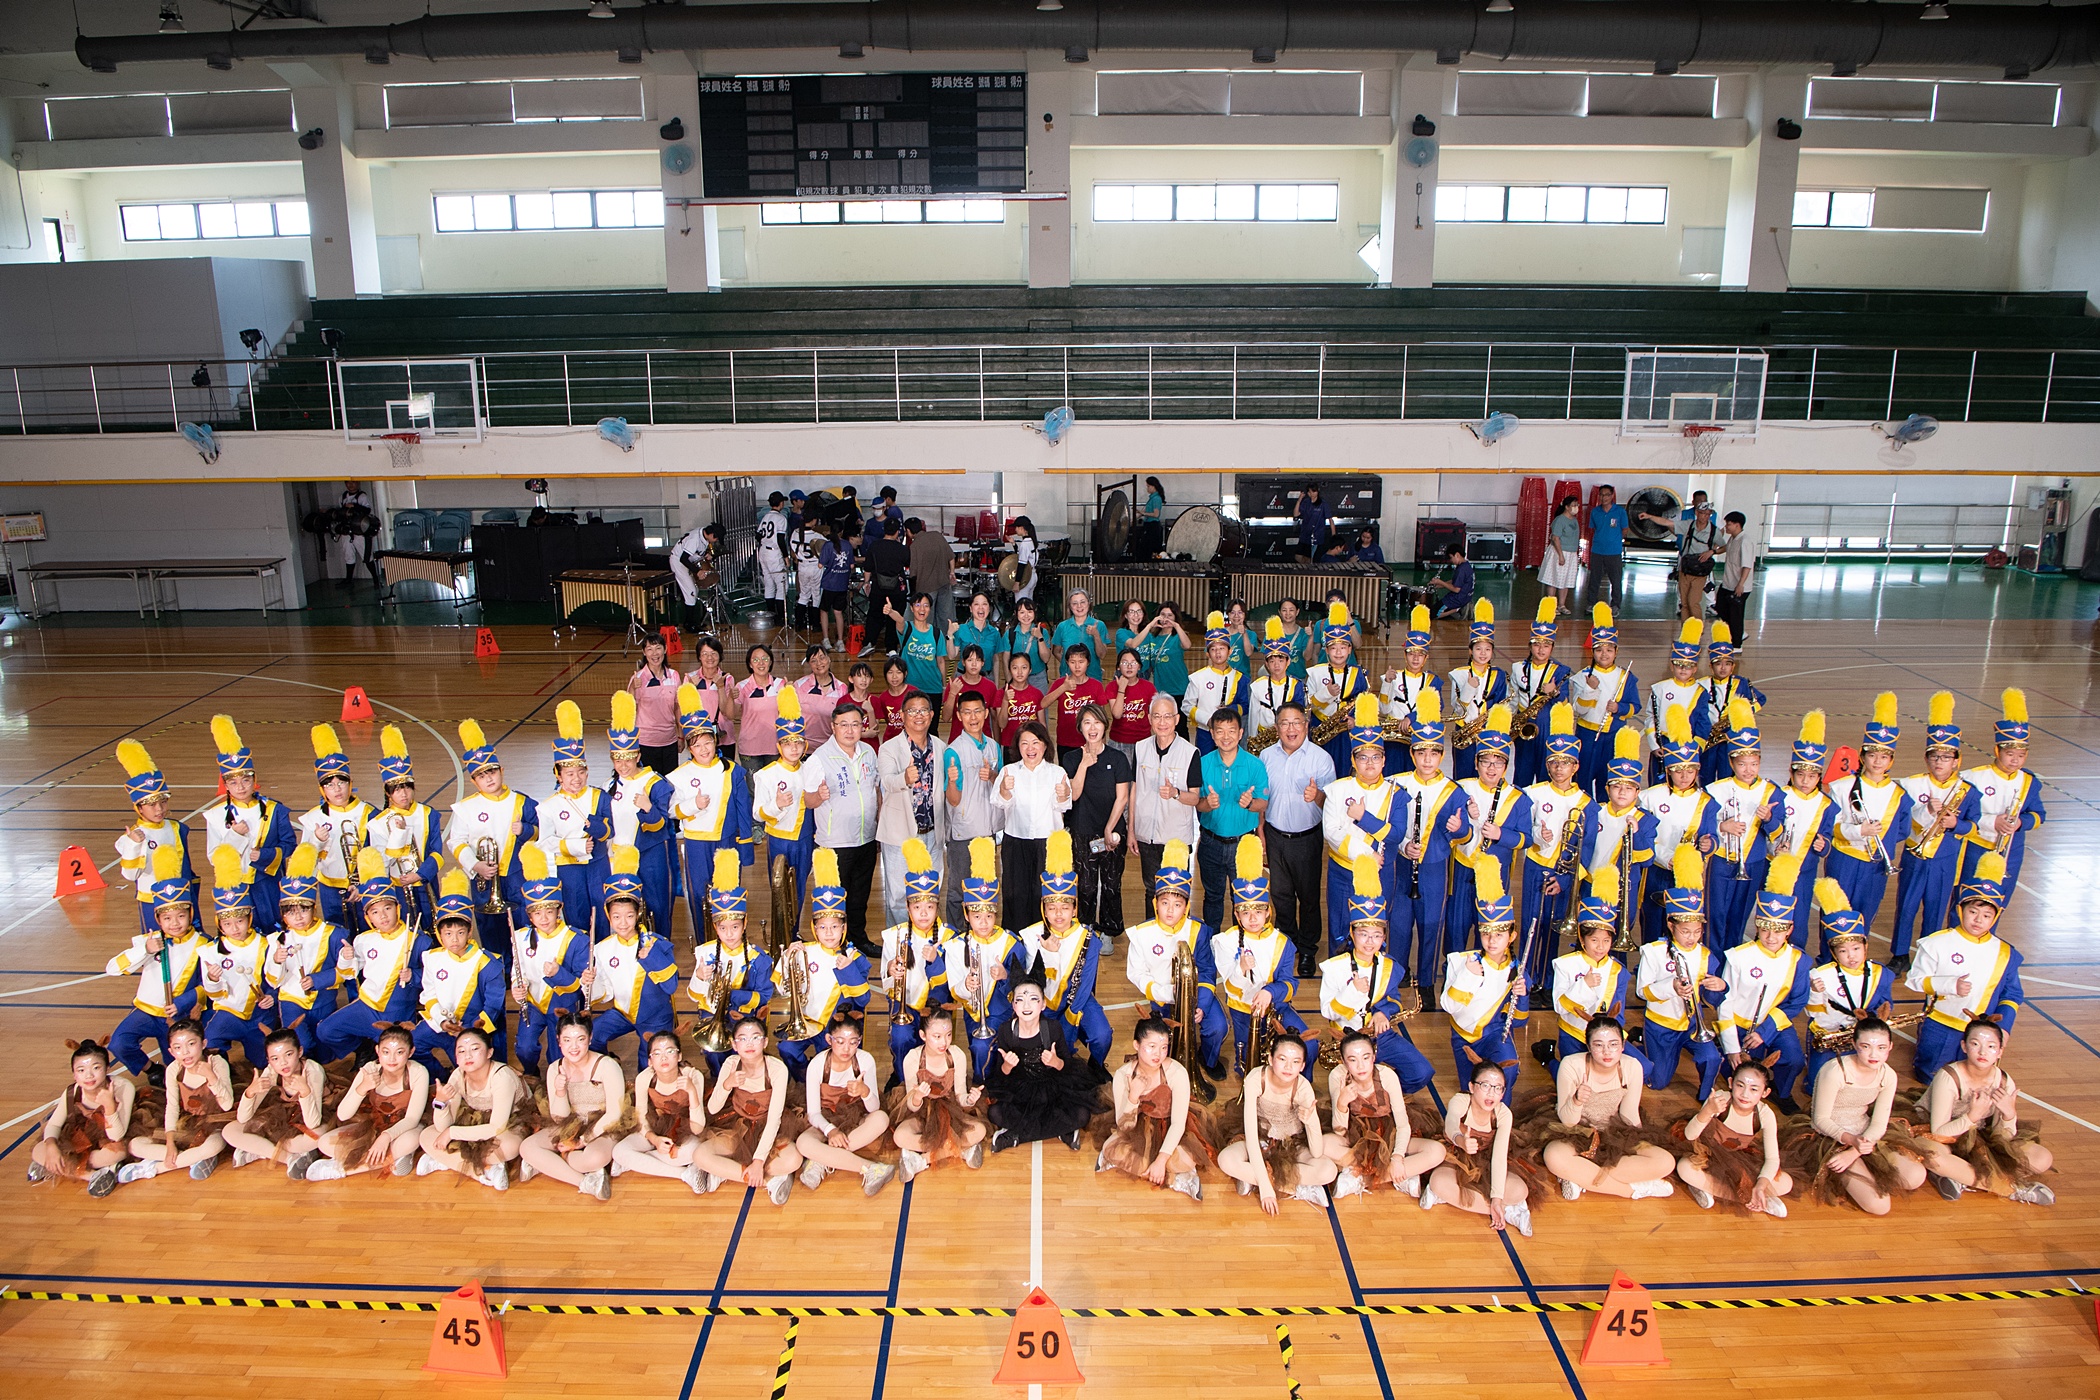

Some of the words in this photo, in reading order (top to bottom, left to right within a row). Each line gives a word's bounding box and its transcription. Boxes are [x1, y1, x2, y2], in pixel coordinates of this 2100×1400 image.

[700, 81, 743, 93] 球員姓名
[762, 80, 775, 92] 犯規
[778, 79, 791, 92] 得分
[931, 76, 974, 89] 球員姓名
[994, 76, 1007, 88] 犯規
[1010, 76, 1023, 88] 得分
[809, 150, 829, 160] 得分
[853, 149, 874, 159] 局數
[897, 149, 918, 159] 得分
[480, 634, 493, 646] 35
[670, 631, 678, 643] 40
[352, 695, 361, 707] 4
[1012, 705, 1037, 714] BOAI
[1840, 757, 1850, 772] 3
[70, 859, 84, 877] 2
[1606, 1309, 1648, 1337] 45
[442, 1317, 481, 1347] 45
[1016, 1330, 1060, 1359] 50
